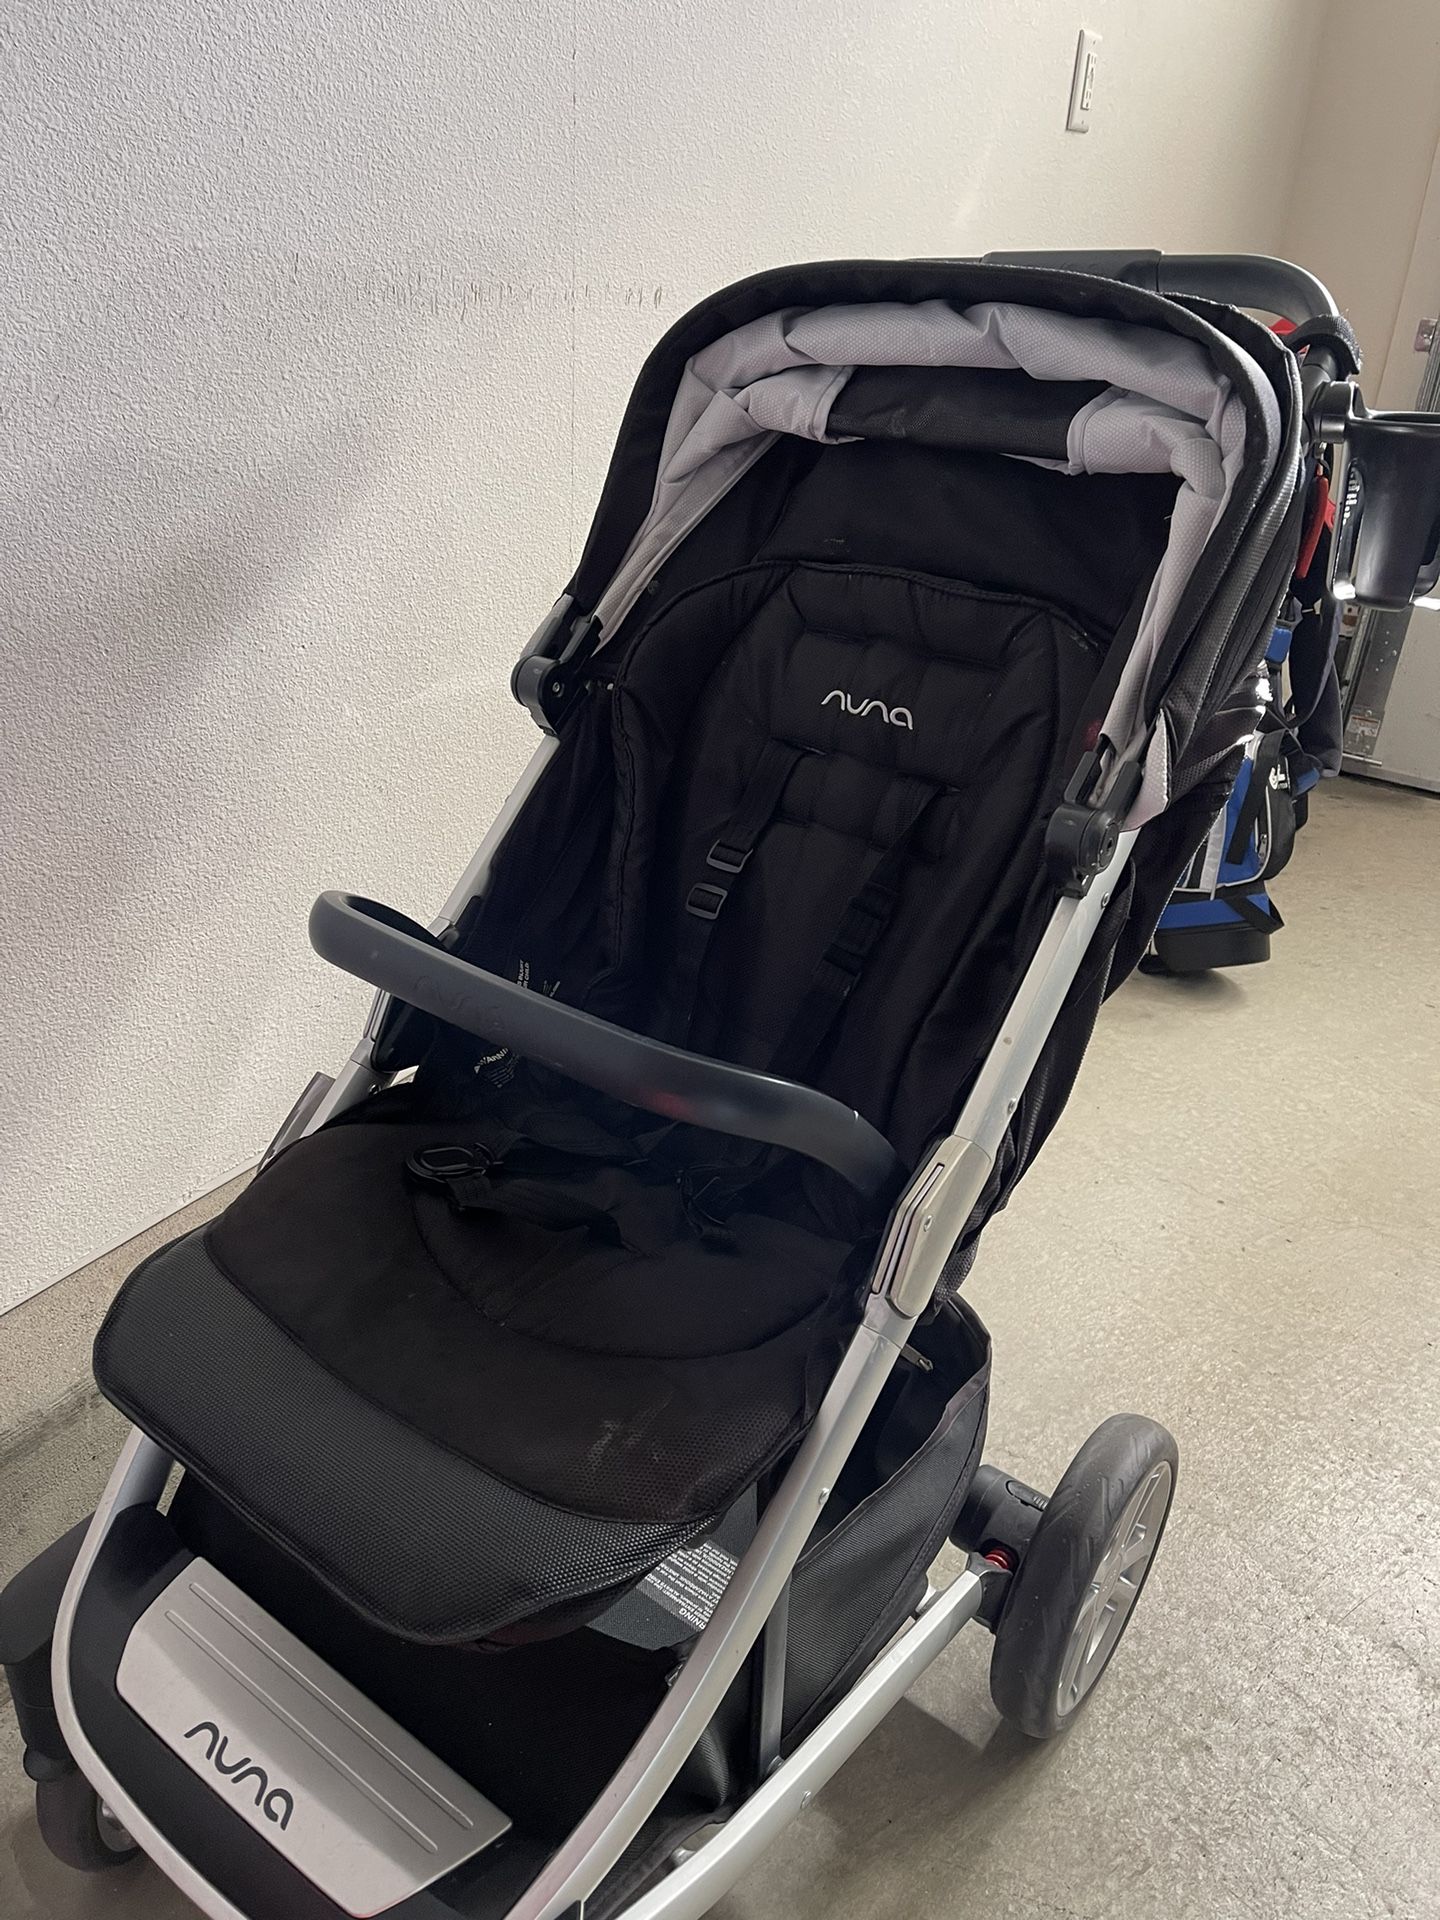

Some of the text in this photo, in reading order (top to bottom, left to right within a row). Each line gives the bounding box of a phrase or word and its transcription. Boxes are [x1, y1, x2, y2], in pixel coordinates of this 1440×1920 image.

[820, 689, 914, 731] nuna
[678, 1607, 707, 1630] RNING
[183, 1721, 294, 1831] nuna
